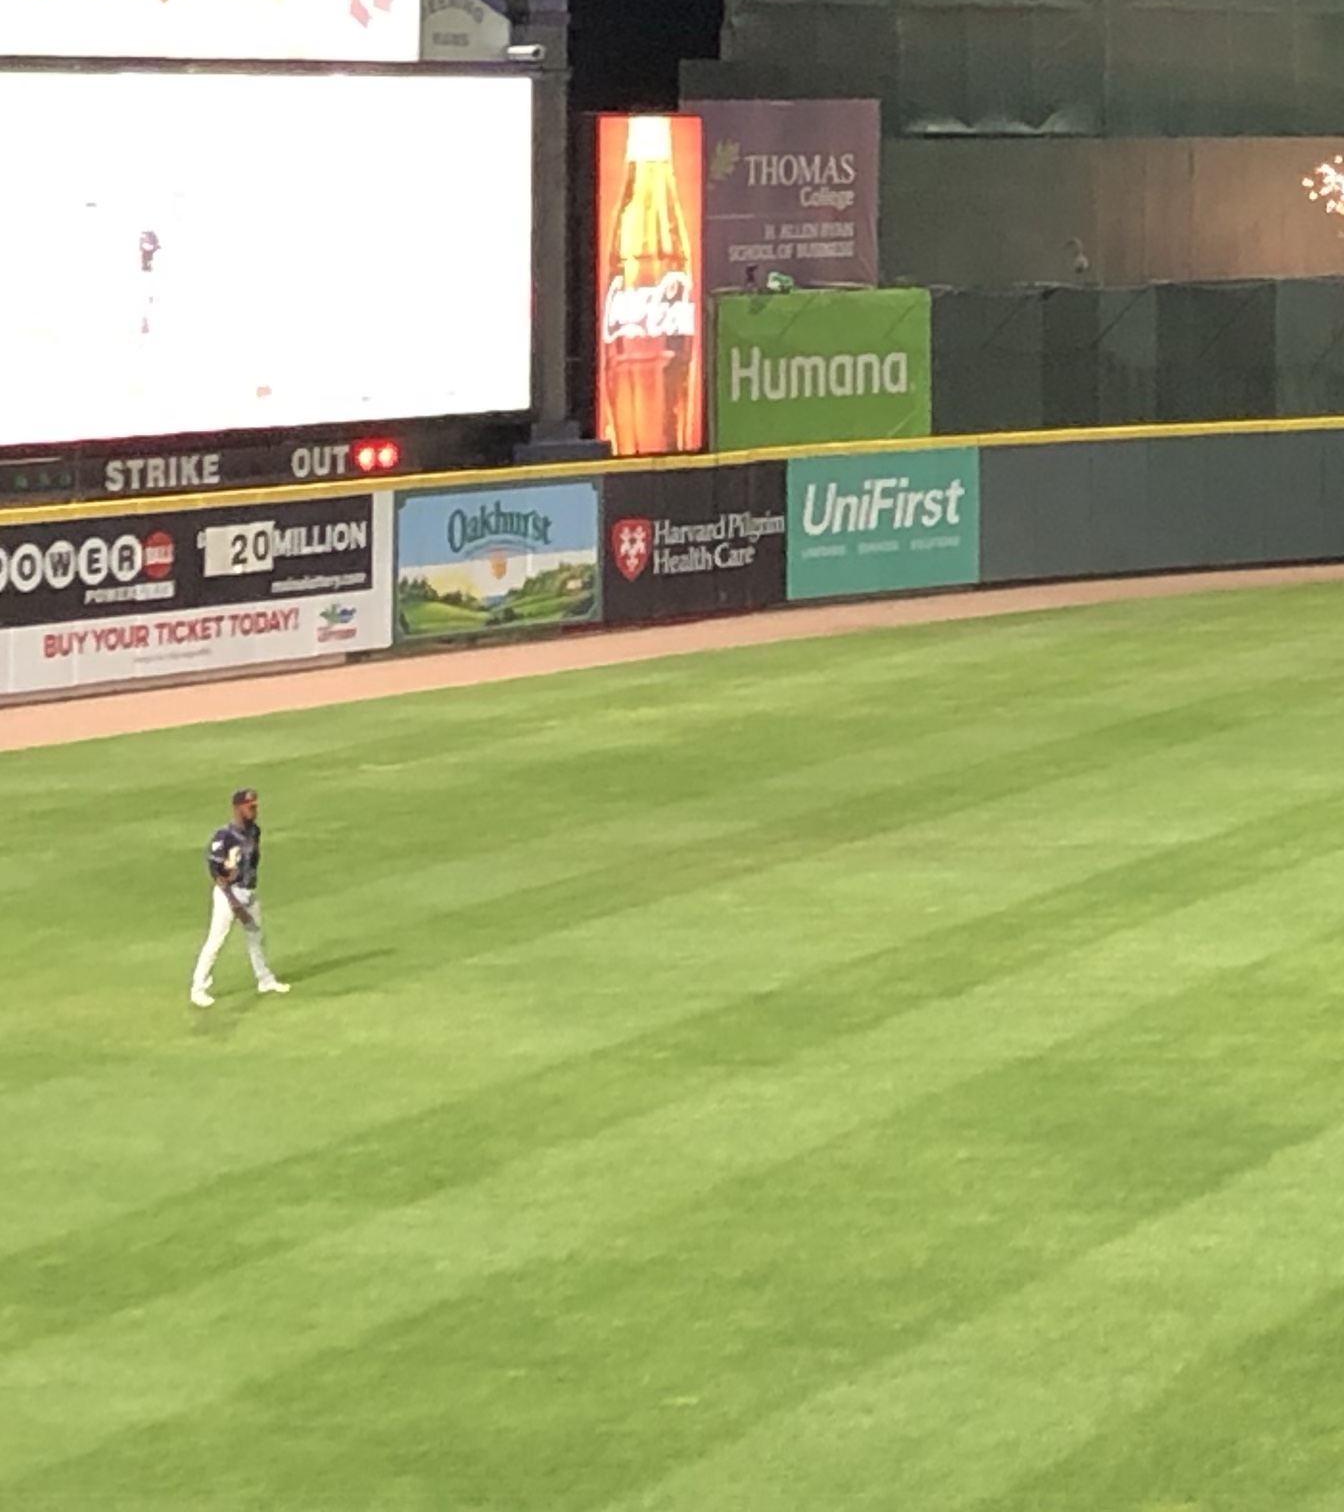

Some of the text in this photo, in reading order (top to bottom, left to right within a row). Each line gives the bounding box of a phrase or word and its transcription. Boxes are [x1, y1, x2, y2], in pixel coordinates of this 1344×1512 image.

[745, 153, 857, 186] THOMAS
[800, 186, 856, 210] College
[730, 345, 908, 403] Humana
[104, 453, 221, 492] STRIKE
[291, 444, 350, 479] OUT
[802, 476, 966, 536] UniFirst
[273, 520, 367, 558] MILLION
[447, 500, 552, 554] Oakhurst
[653, 509, 785, 546] Harvard Pilgrim
[230, 530, 270, 566] 20
[652, 542, 756, 575] Health Care
[43, 631, 88, 659] BUY
[92, 624, 150, 652] YOUR
[153, 615, 225, 646] TICKET
[227, 607, 300, 638] TODAY!
